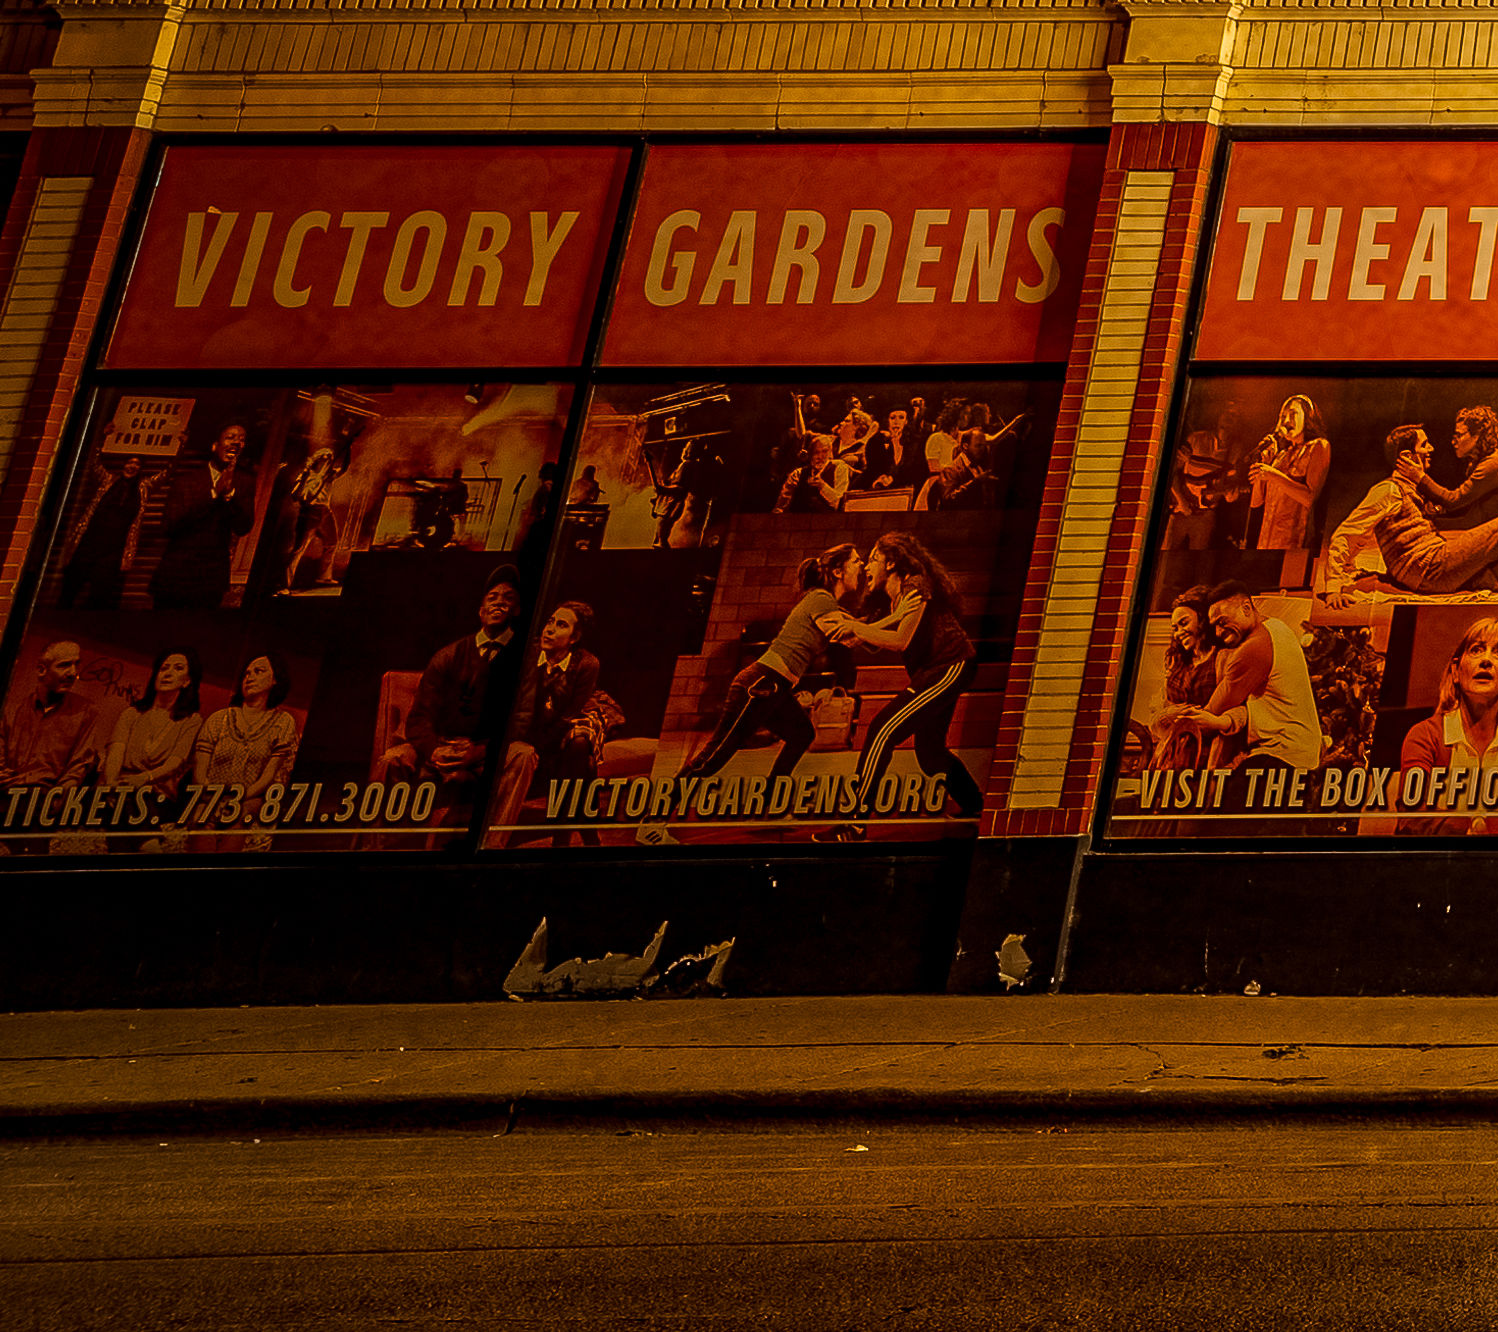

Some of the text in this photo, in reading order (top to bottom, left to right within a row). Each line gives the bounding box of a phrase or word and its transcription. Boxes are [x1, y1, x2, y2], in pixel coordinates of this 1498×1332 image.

[174, 206, 580, 308] VICTORY
[644, 207, 1065, 306] GARDENS
[128, 402, 182, 415] PLEASE
[131, 418, 167, 430] CLAP
[114, 433, 173, 446] FOR HIM
[3, 781, 438, 827] TICKETS: 773.871.3000
[545, 772, 948, 818] VICTORYGARDENS.ORG
[1140, 768, 1233, 809] VISIT
[1245, 768, 1309, 807] THE
[1320, 767, 1392, 807] BOX
